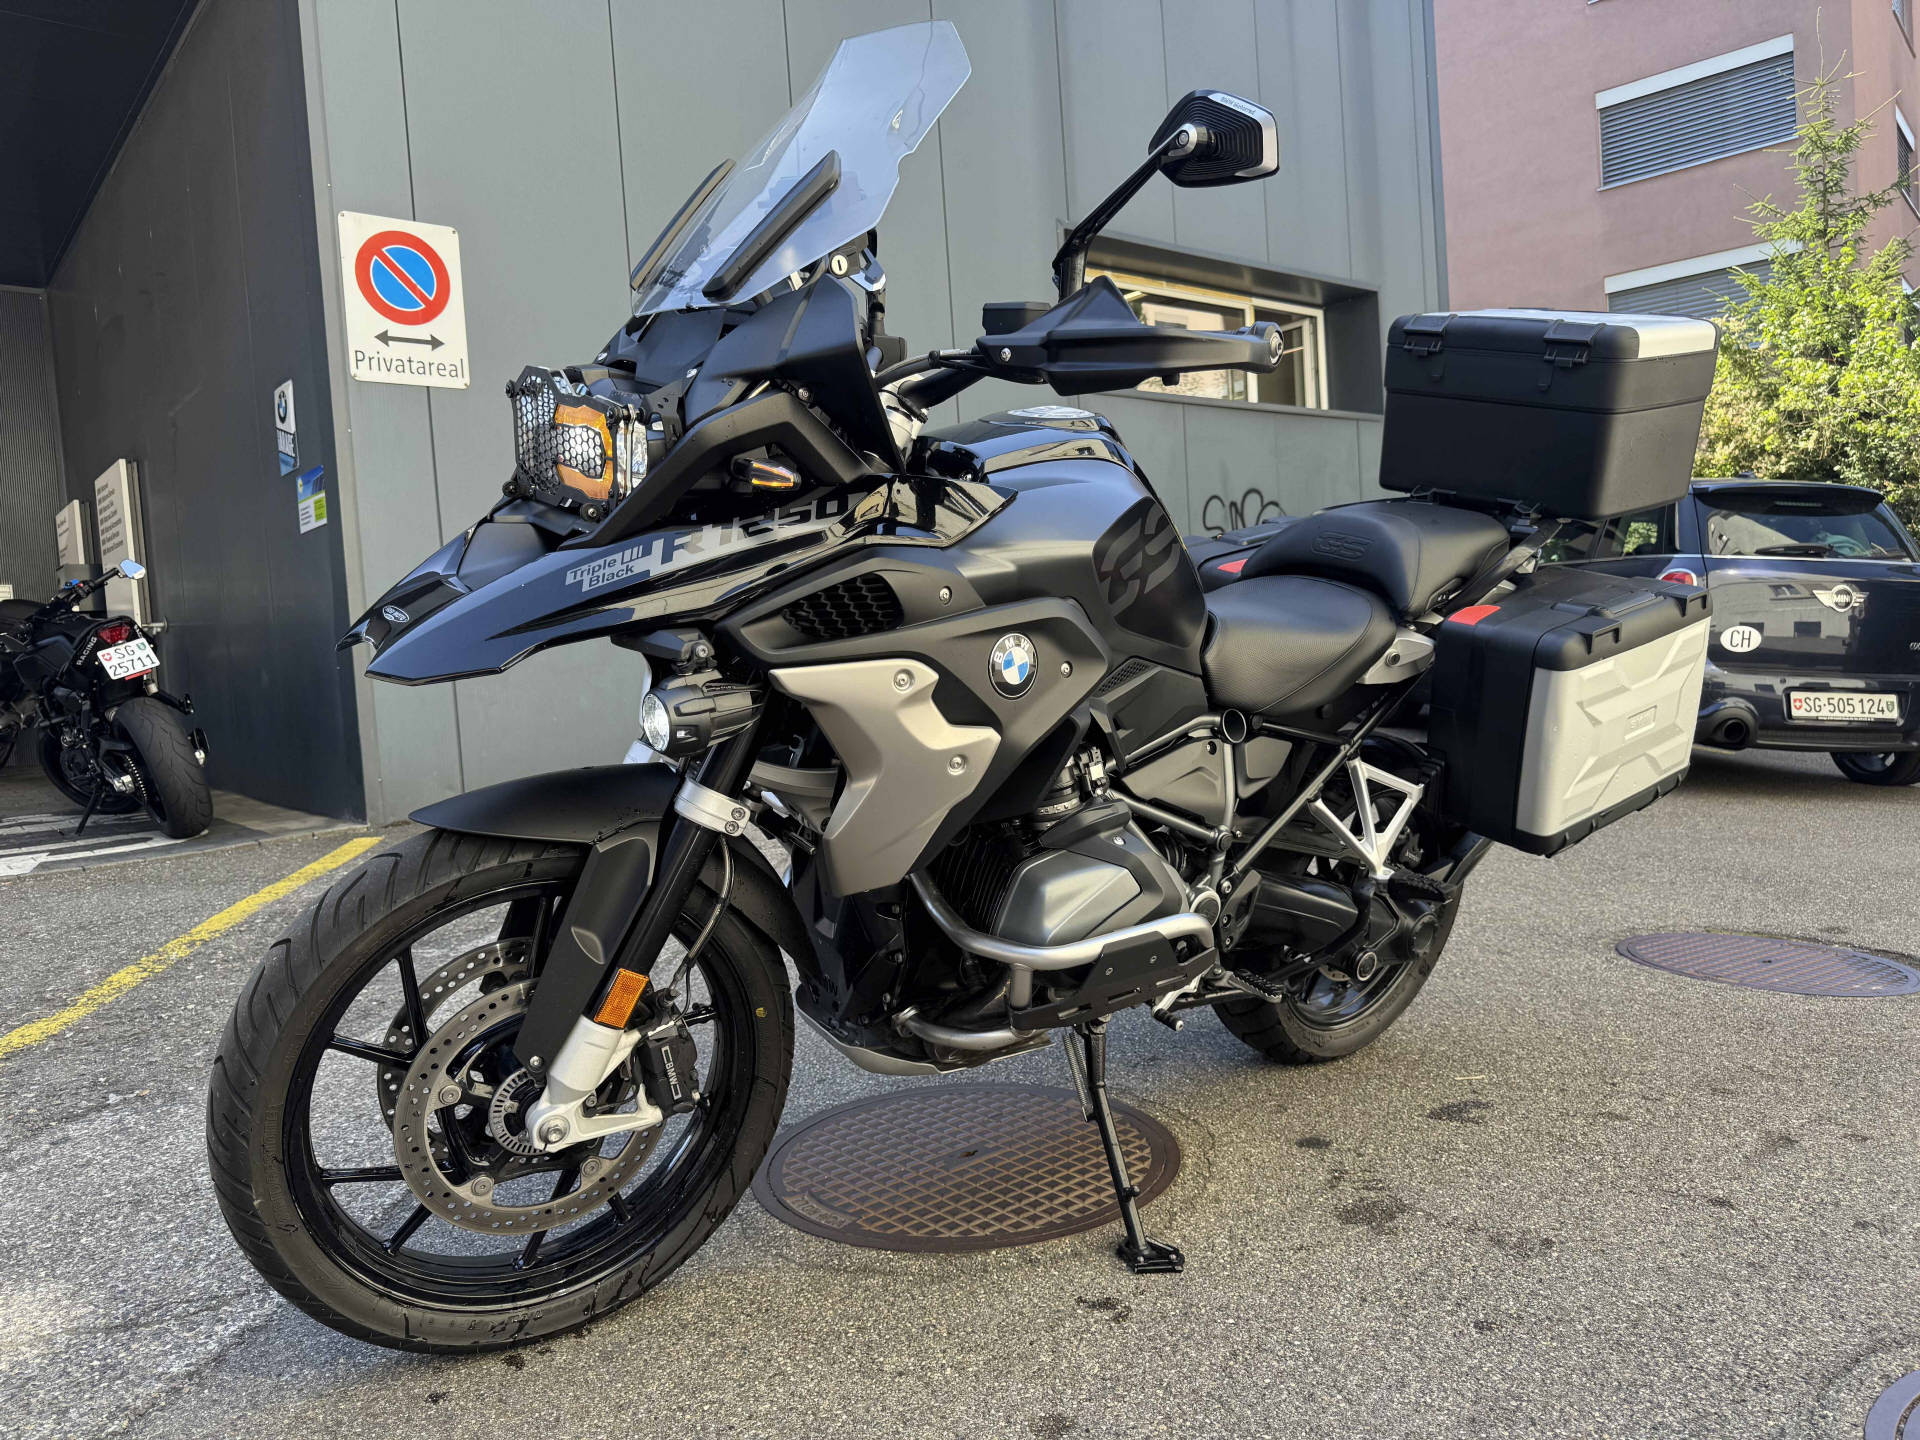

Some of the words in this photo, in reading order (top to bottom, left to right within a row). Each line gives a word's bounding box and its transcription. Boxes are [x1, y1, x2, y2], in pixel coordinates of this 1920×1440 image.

[354, 350, 465, 379] Privatareal
[570, 558, 617, 581] Triple
[589, 564, 635, 588] Black
[1833, 593, 1851, 603] MINI
[994, 636, 1031, 664] BMW
[1729, 629, 1752, 648] CH
[76, 636, 98, 666] RACING
[114, 644, 136, 660] SG
[109, 653, 157, 677] 25711
[665, 1062, 679, 1085] BMW
